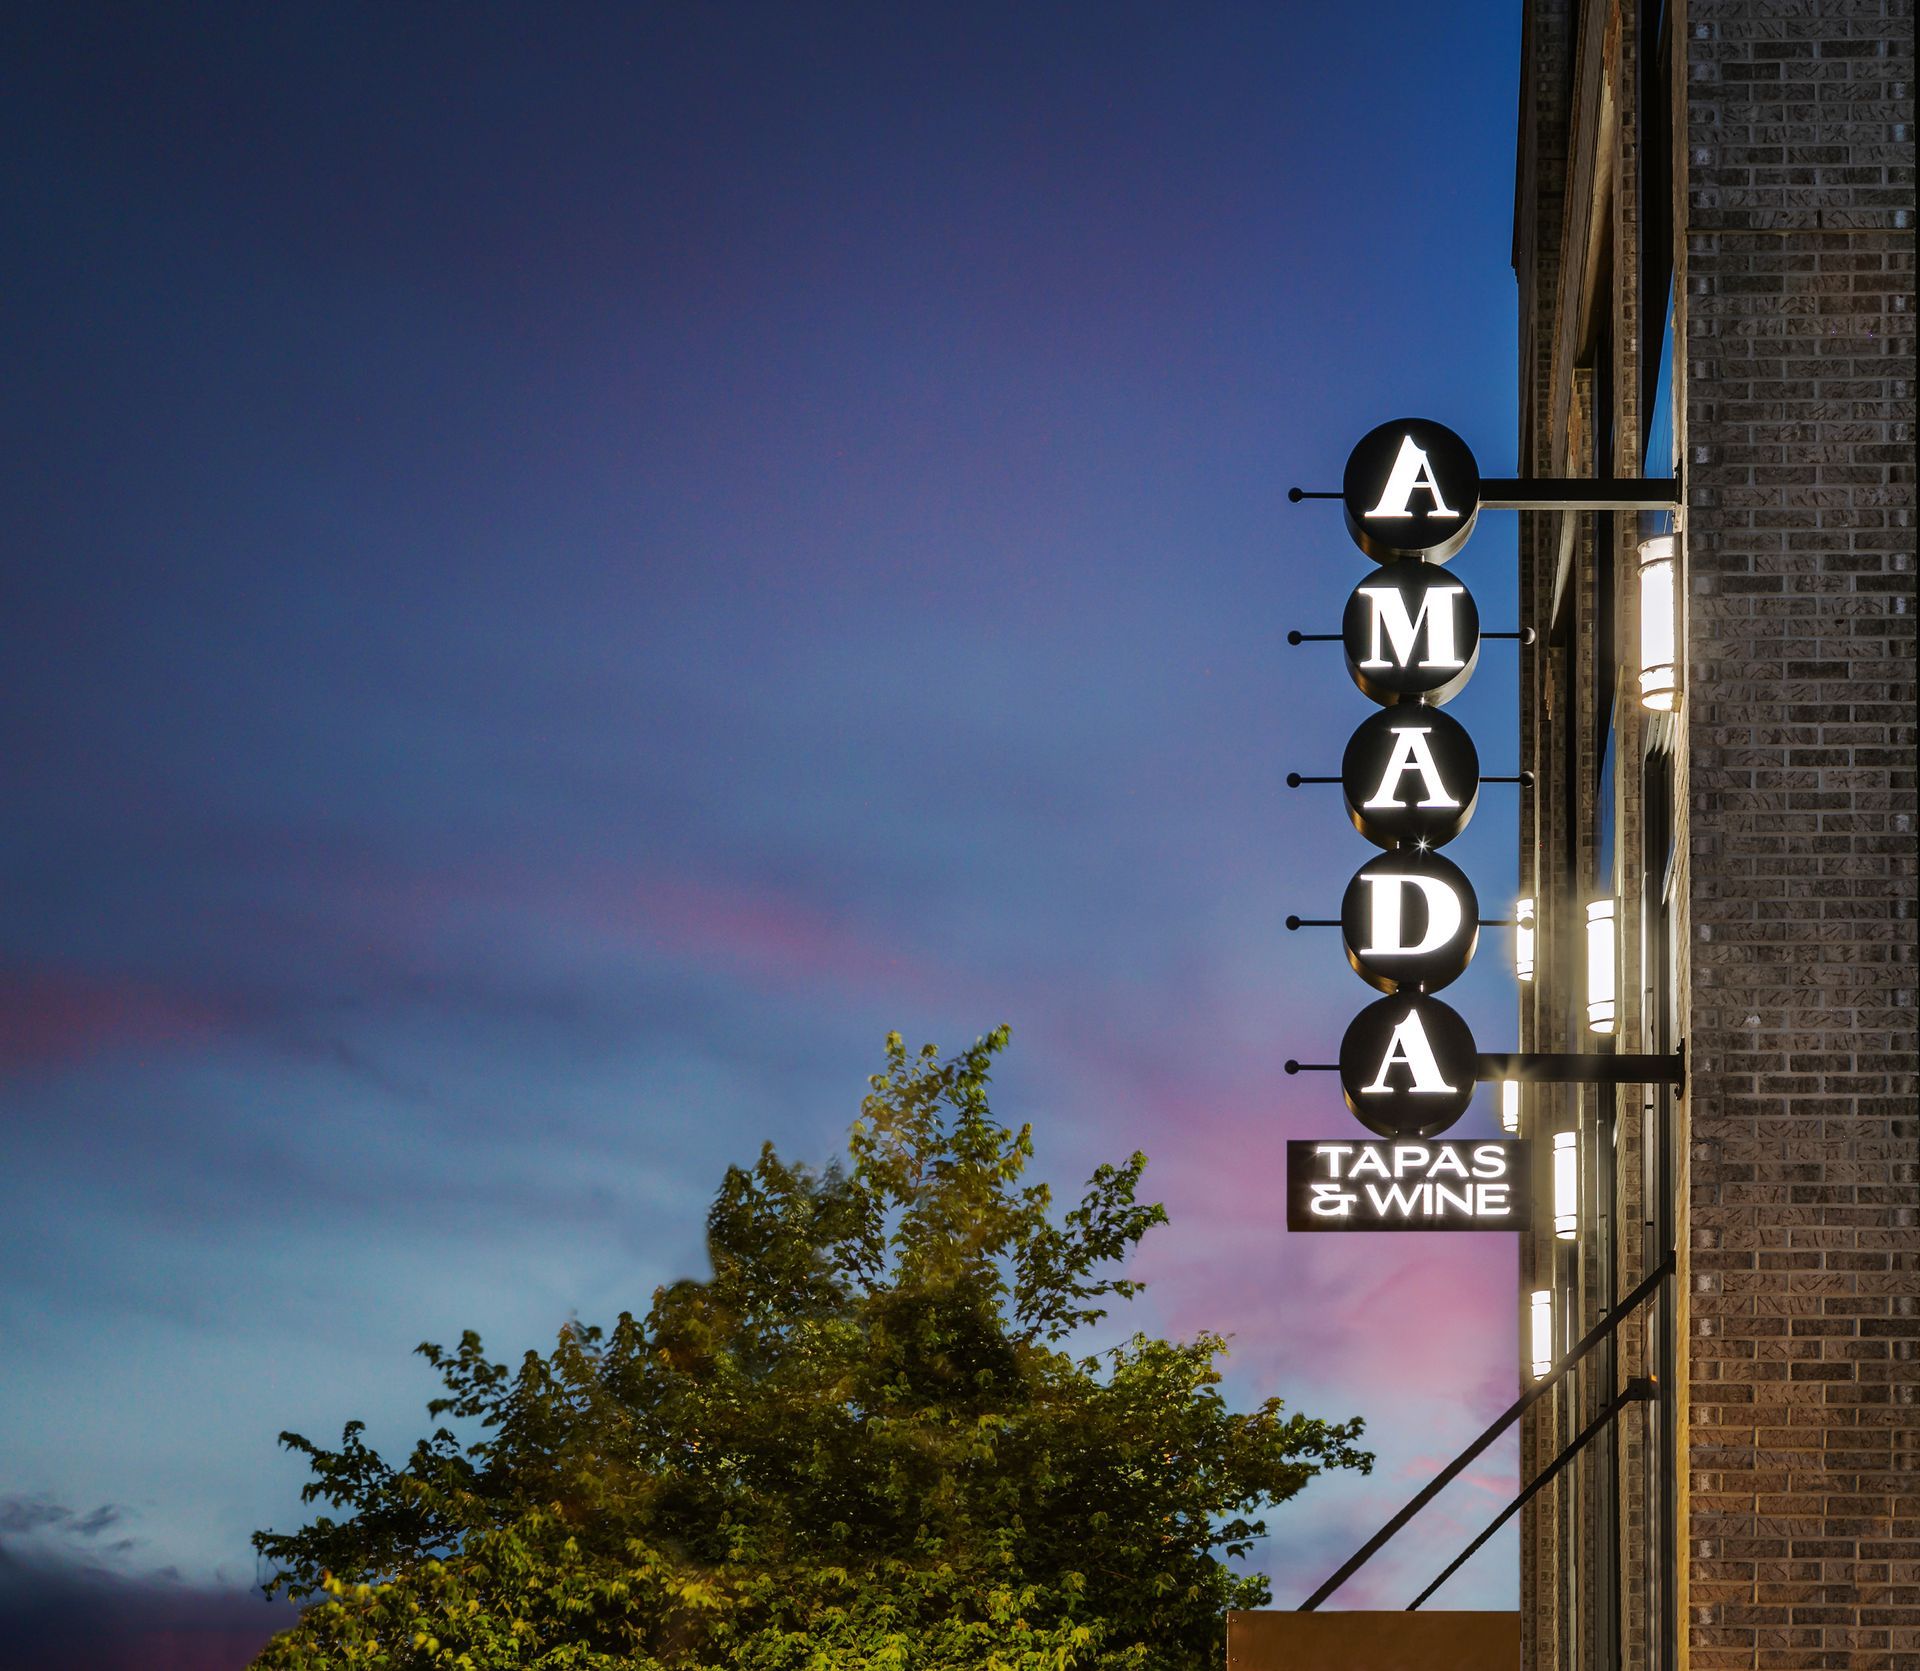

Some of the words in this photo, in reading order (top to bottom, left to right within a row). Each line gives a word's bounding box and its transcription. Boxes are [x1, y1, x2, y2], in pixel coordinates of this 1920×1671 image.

[1358, 434, 1466, 1093] AMADA
[1315, 1145, 1507, 1178] TAPAS
[1310, 1183, 1358, 1216] &
[1365, 1183, 1511, 1217] WINE
